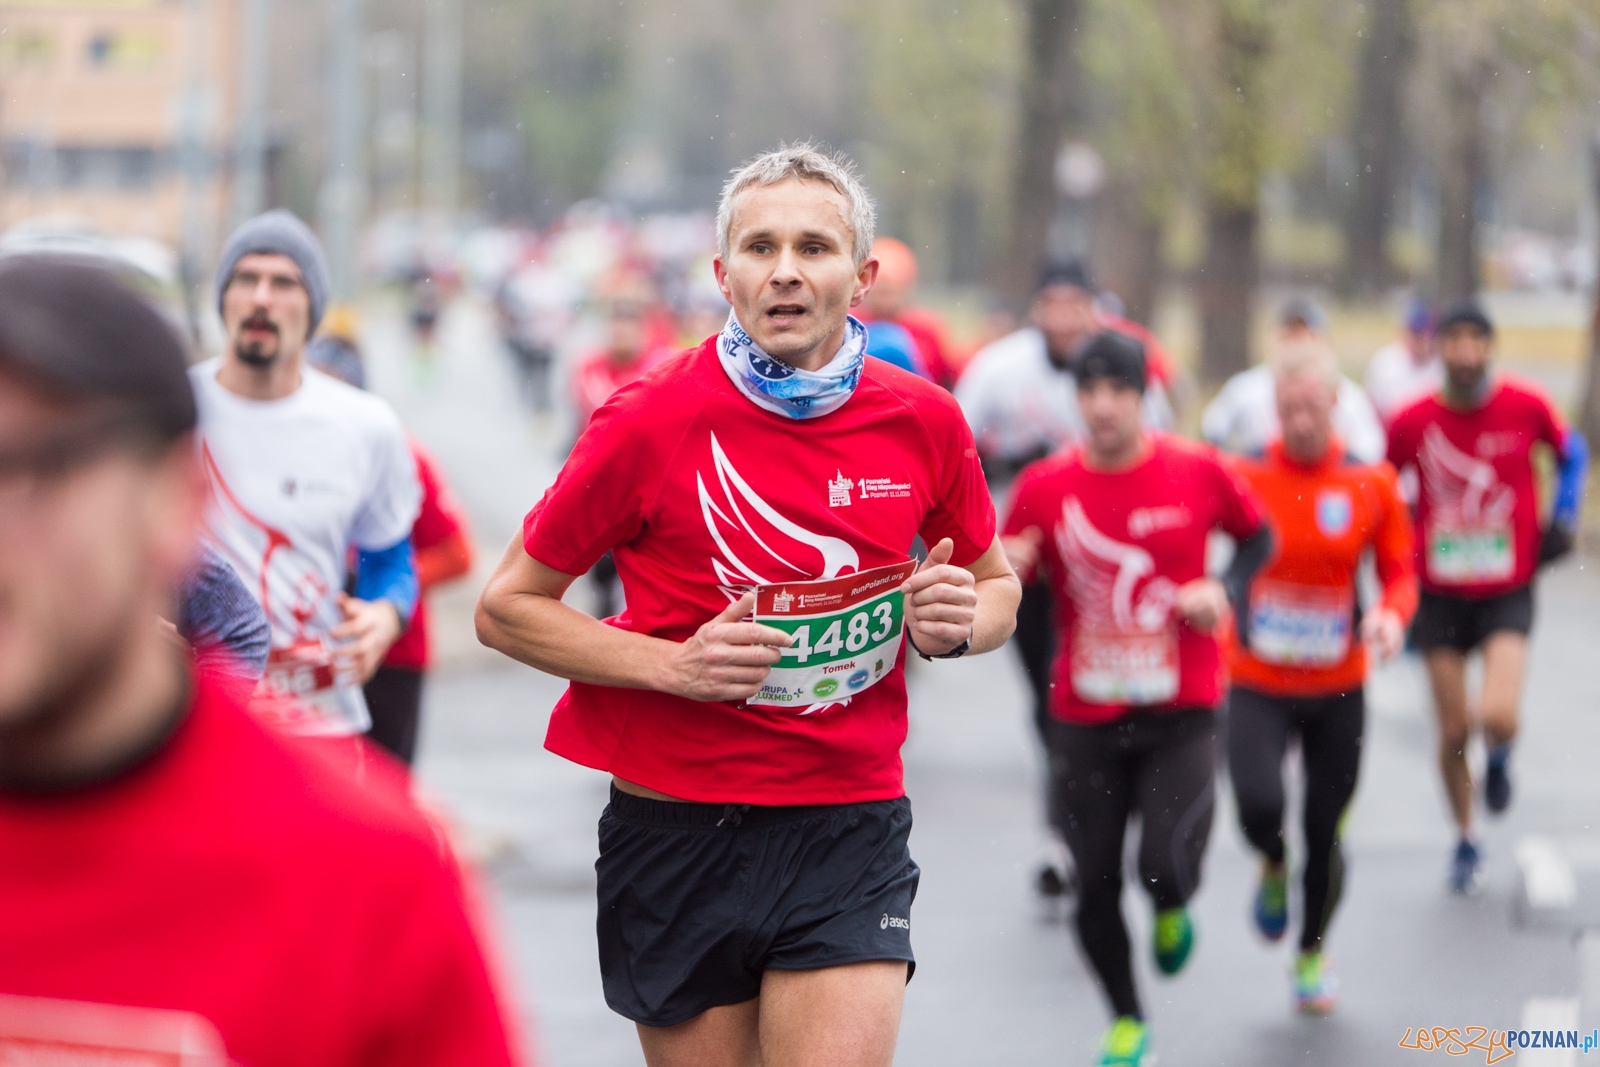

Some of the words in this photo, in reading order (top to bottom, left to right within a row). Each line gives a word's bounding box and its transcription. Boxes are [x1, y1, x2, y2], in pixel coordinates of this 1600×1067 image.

[858, 478, 869, 499] 1
[851, 572, 904, 596] RunPoland.org
[797, 594, 805, 608] 1
[781, 601, 893, 663] 4483
[822, 661, 856, 675] Tomek
[757, 691, 793, 702] LUXMED
[889, 917, 909, 929] asics
